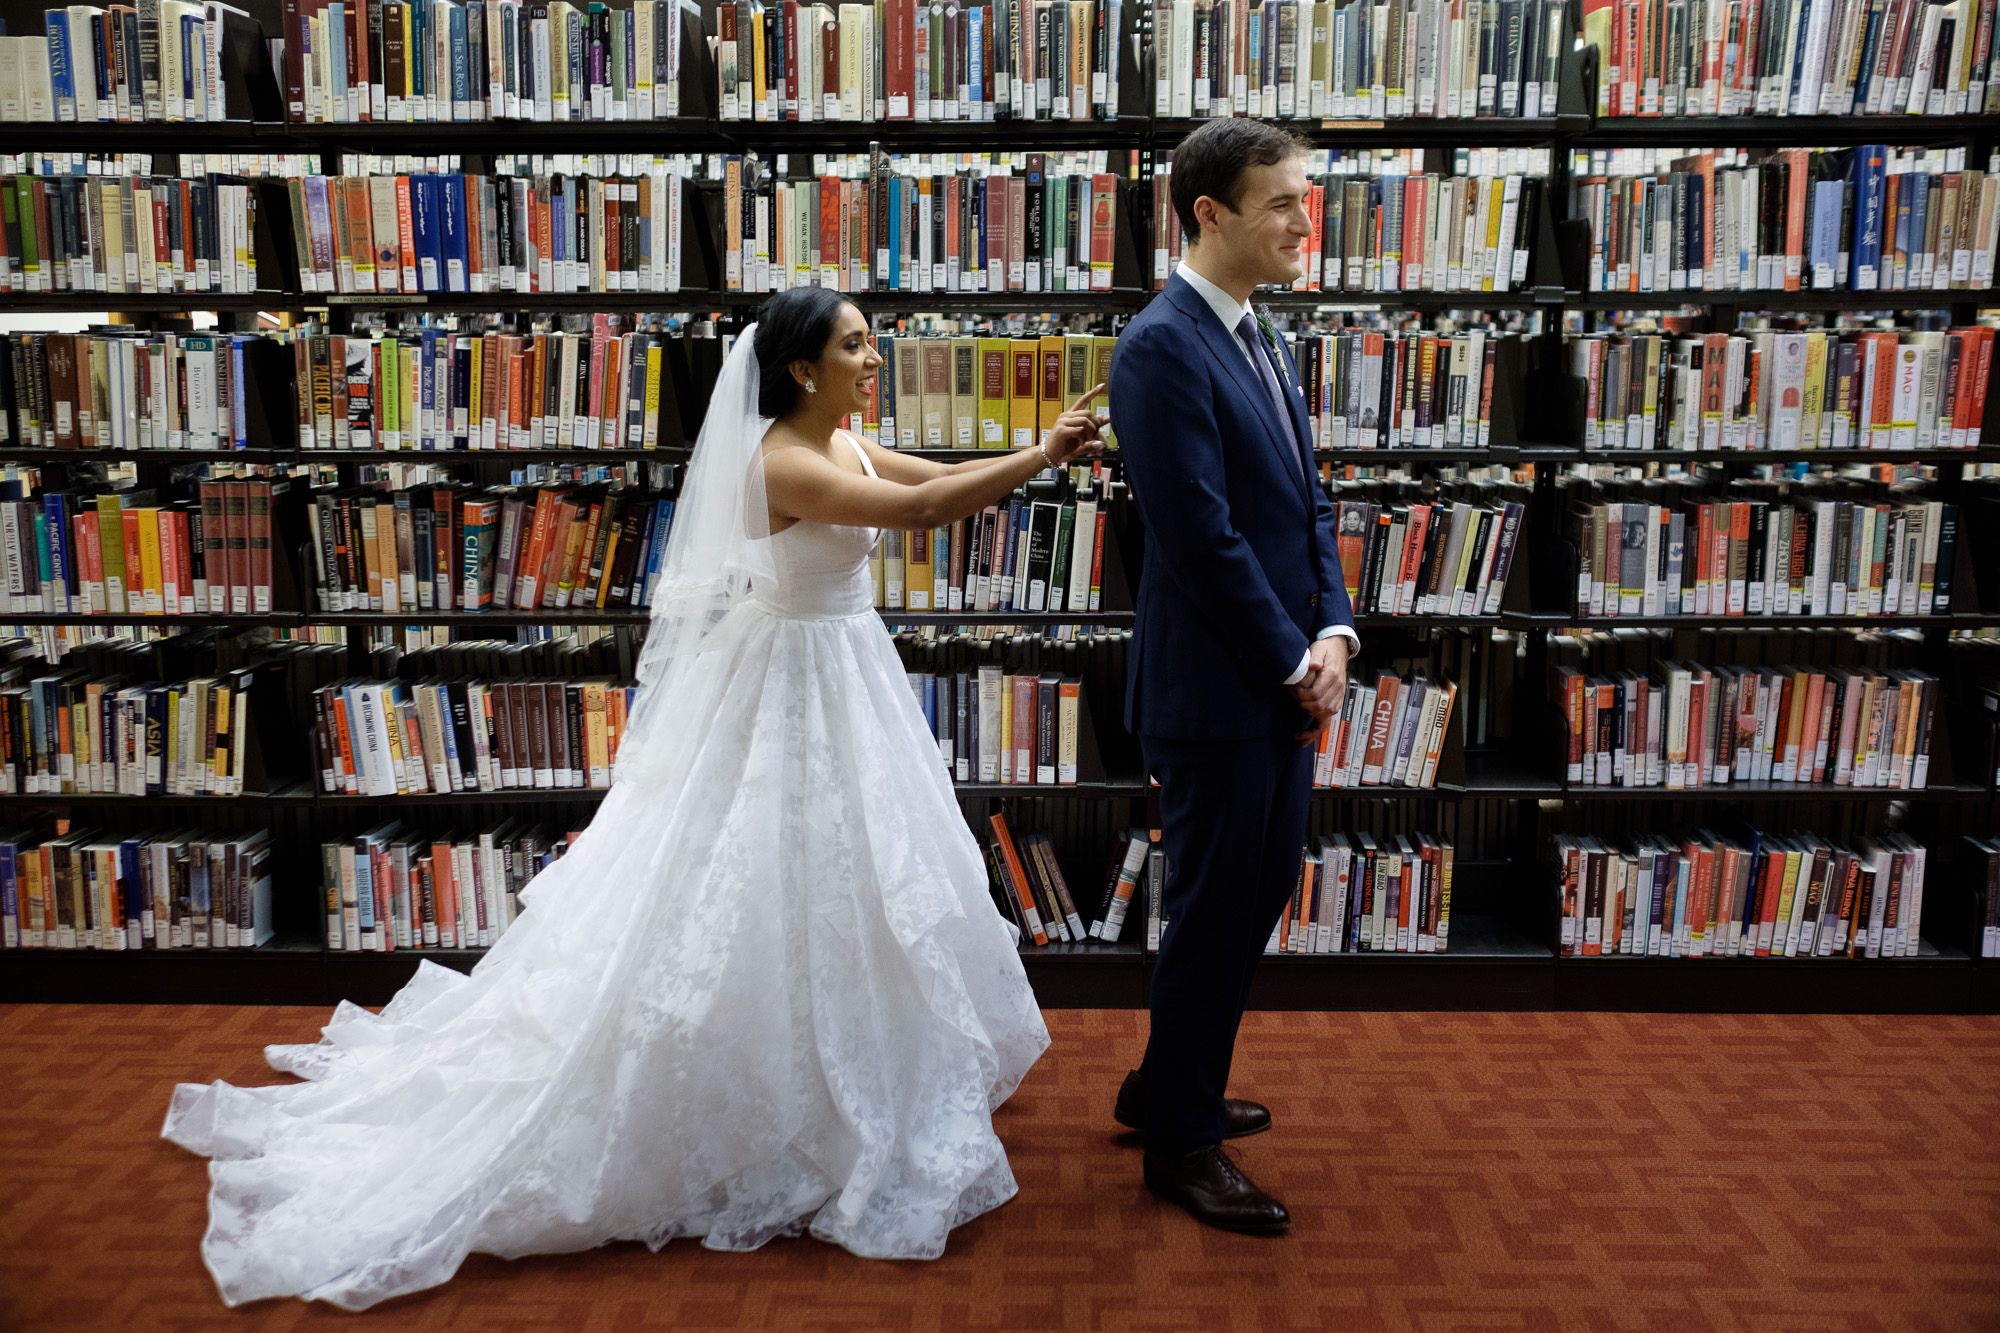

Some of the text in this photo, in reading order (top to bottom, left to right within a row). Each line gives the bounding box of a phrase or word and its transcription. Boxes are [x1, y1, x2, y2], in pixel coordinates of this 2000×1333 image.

[166, 21, 174, 52] HISTORY
[639, 10, 648, 58] TAMERLANE
[1010, 2, 1018, 43] CHINA
[1040, 13, 1049, 47] China
[1509, 16, 1518, 55] CHINA
[49, 25, 60, 76] ROMANIA
[116, 40, 124, 79] Romanians
[168, 56, 174, 66] OF
[206, 23, 216, 95] IN EUROPE'S SHADOW
[454, 37, 464, 98] THE SILK ROAD
[970, 20, 980, 86] SWALLOWING CLOUDS
[1678, 184, 1686, 213] CHINA
[397, 185, 408, 252] EMPIRE IN HISTORY
[1677, 217, 1685, 247] UNDER
[1013, 242, 1021, 261] Equals
[190, 340, 206, 350] HD
[593, 326, 602, 356] CHINA
[193, 366, 201, 409] BULGARIA
[313, 365, 331, 400] PACIFIC
[423, 366, 432, 403] Pacific Asia
[1350, 334, 1361, 406] THE BITTER PEACE
[1421, 341, 1432, 402] FORGOTTEN ALLY
[1708, 347, 1725, 411] MAO
[1904, 366, 1914, 394] MAO
[154, 382, 162, 413] Bulgaria
[349, 384, 369, 397] WAR
[436, 389, 444, 417] ASIAS
[512, 377, 520, 408] MODERN
[50, 523, 59, 552] PACIFIC
[322, 510, 331, 541] CHINESE
[1413, 522, 1422, 540] Black
[1906, 510, 1924, 533] CHINA
[4, 515, 20, 590] UNRULY WATERS
[162, 542, 170, 562] ASIA
[502, 526, 511, 555] CHINA
[1410, 543, 1419, 562] Hands
[1778, 541, 1788, 568] ZHOU
[1792, 525, 1804, 577] CHINA HIGH
[466, 536, 479, 582] CHINA
[1431, 534, 1446, 589] BEYOND SUFFERING
[146, 718, 160, 755] ASIA
[363, 704, 377, 752] BECOMING CHINA
[386, 712, 398, 746] CHINA
[1371, 700, 1391, 749] CHINA
[1720, 697, 1732, 758] BLOOD LETTERS
[504, 844, 512, 870] CHINA
[358, 868, 370, 916] MODERN CHINA
[1363, 869, 1373, 914] GOVERNING CHINA
[1377, 863, 1386, 890] LIN BIAO
[1807, 881, 1819, 904] MAO
[1842, 861, 1859, 917] CHINA RISING
[423, 874, 433, 920] GREAT WALL
[1875, 897, 1883, 915] DENG
